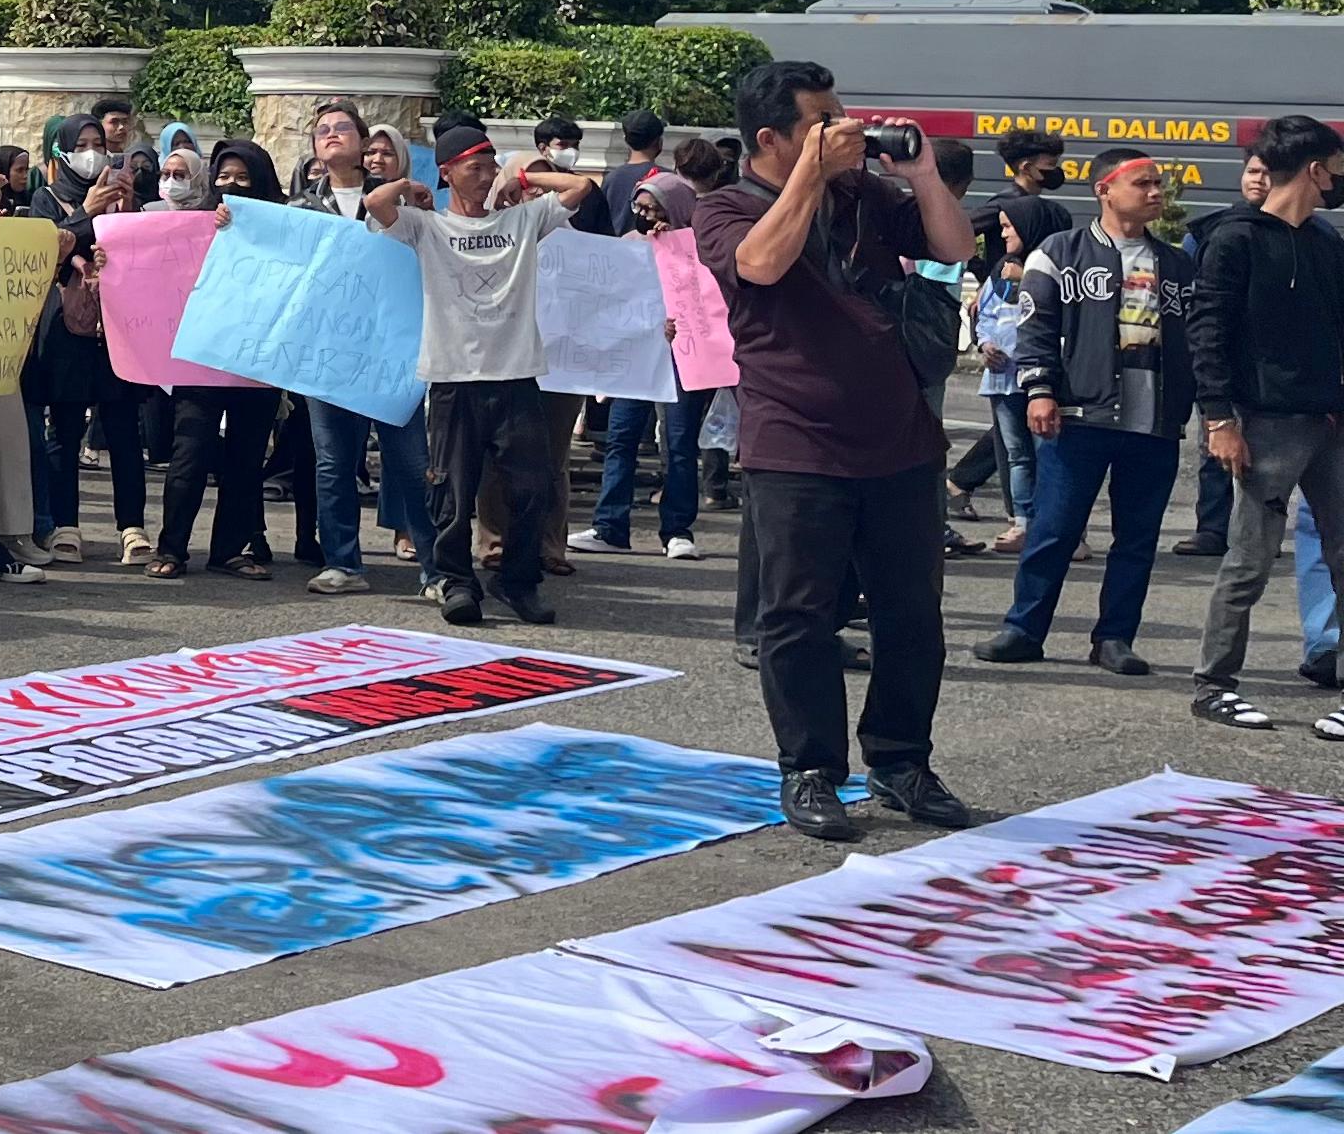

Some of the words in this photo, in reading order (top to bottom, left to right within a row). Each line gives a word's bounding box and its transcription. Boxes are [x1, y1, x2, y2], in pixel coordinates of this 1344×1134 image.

[976, 115, 1036, 135] RAN
[1045, 116, 1099, 139] PAL
[1107, 118, 1231, 143] DALMAS
[449, 233, 516, 252] FREEDOM
[2, 246, 49, 276] BUKAN
